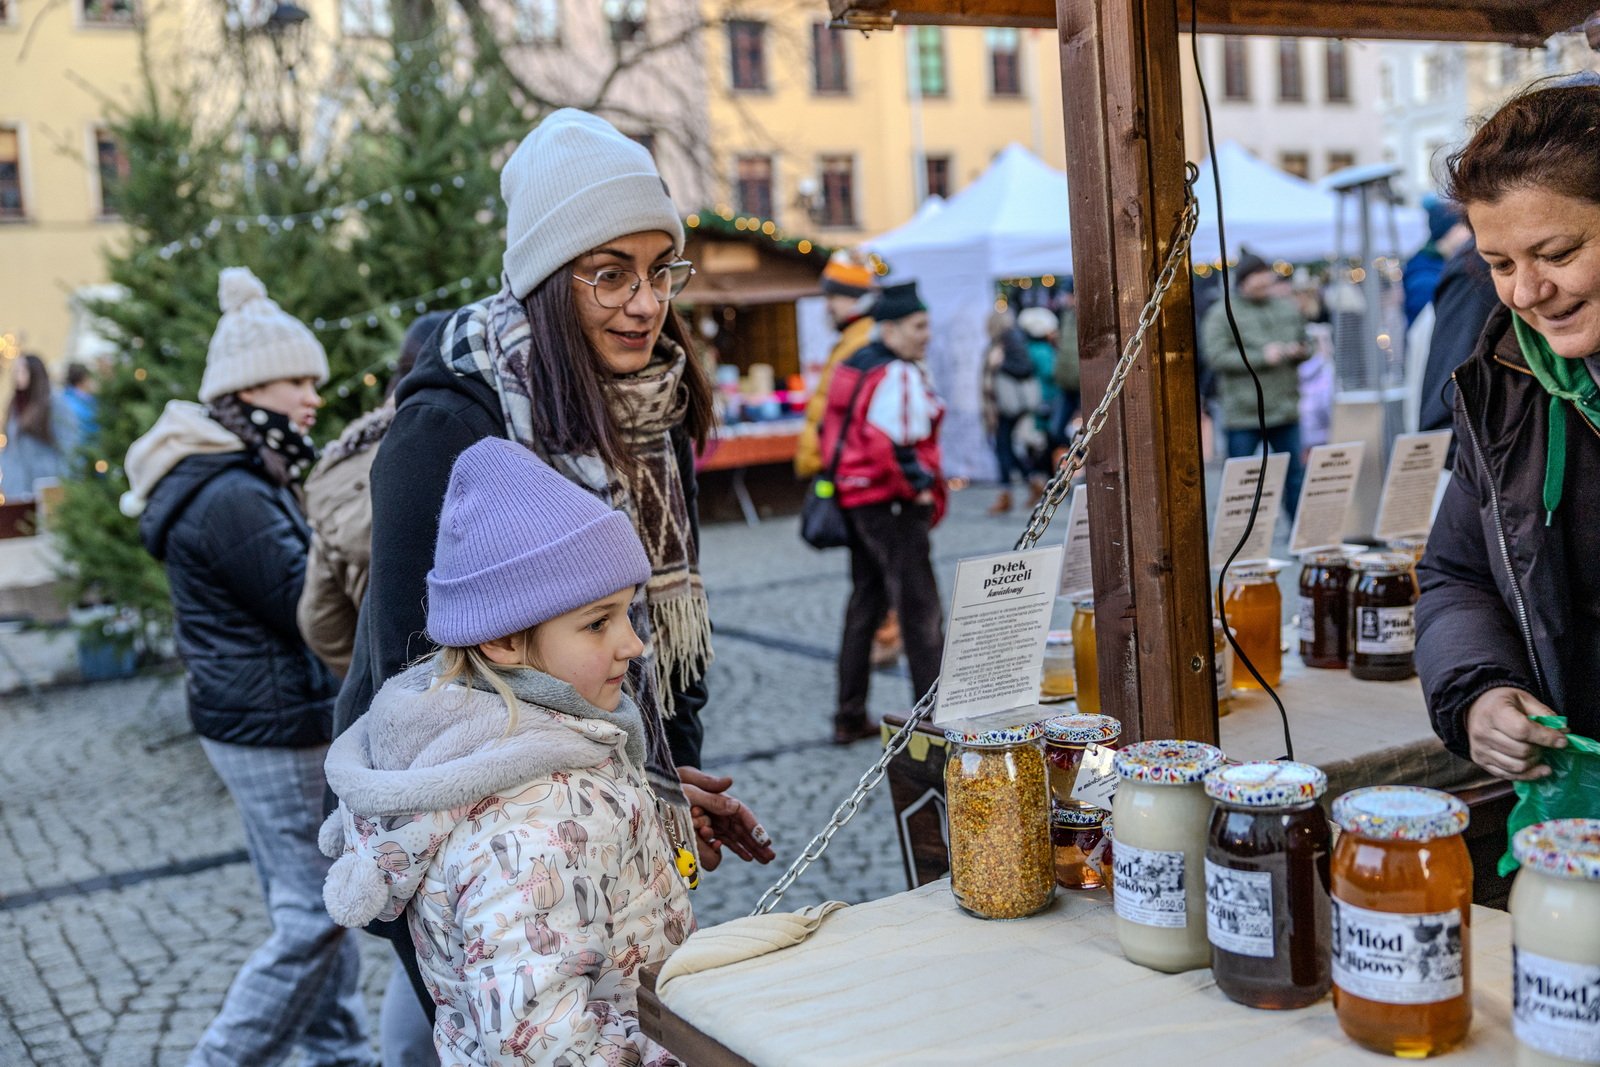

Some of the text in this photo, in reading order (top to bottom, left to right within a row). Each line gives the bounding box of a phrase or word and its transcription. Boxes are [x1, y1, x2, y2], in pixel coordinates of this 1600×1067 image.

[983, 569, 1032, 589] pszczeli
[992, 560, 1026, 575] Pyłek
[1346, 924, 1403, 952] Miód
[1346, 951, 1407, 979] lipowy
[1525, 973, 1587, 1004] Miód
